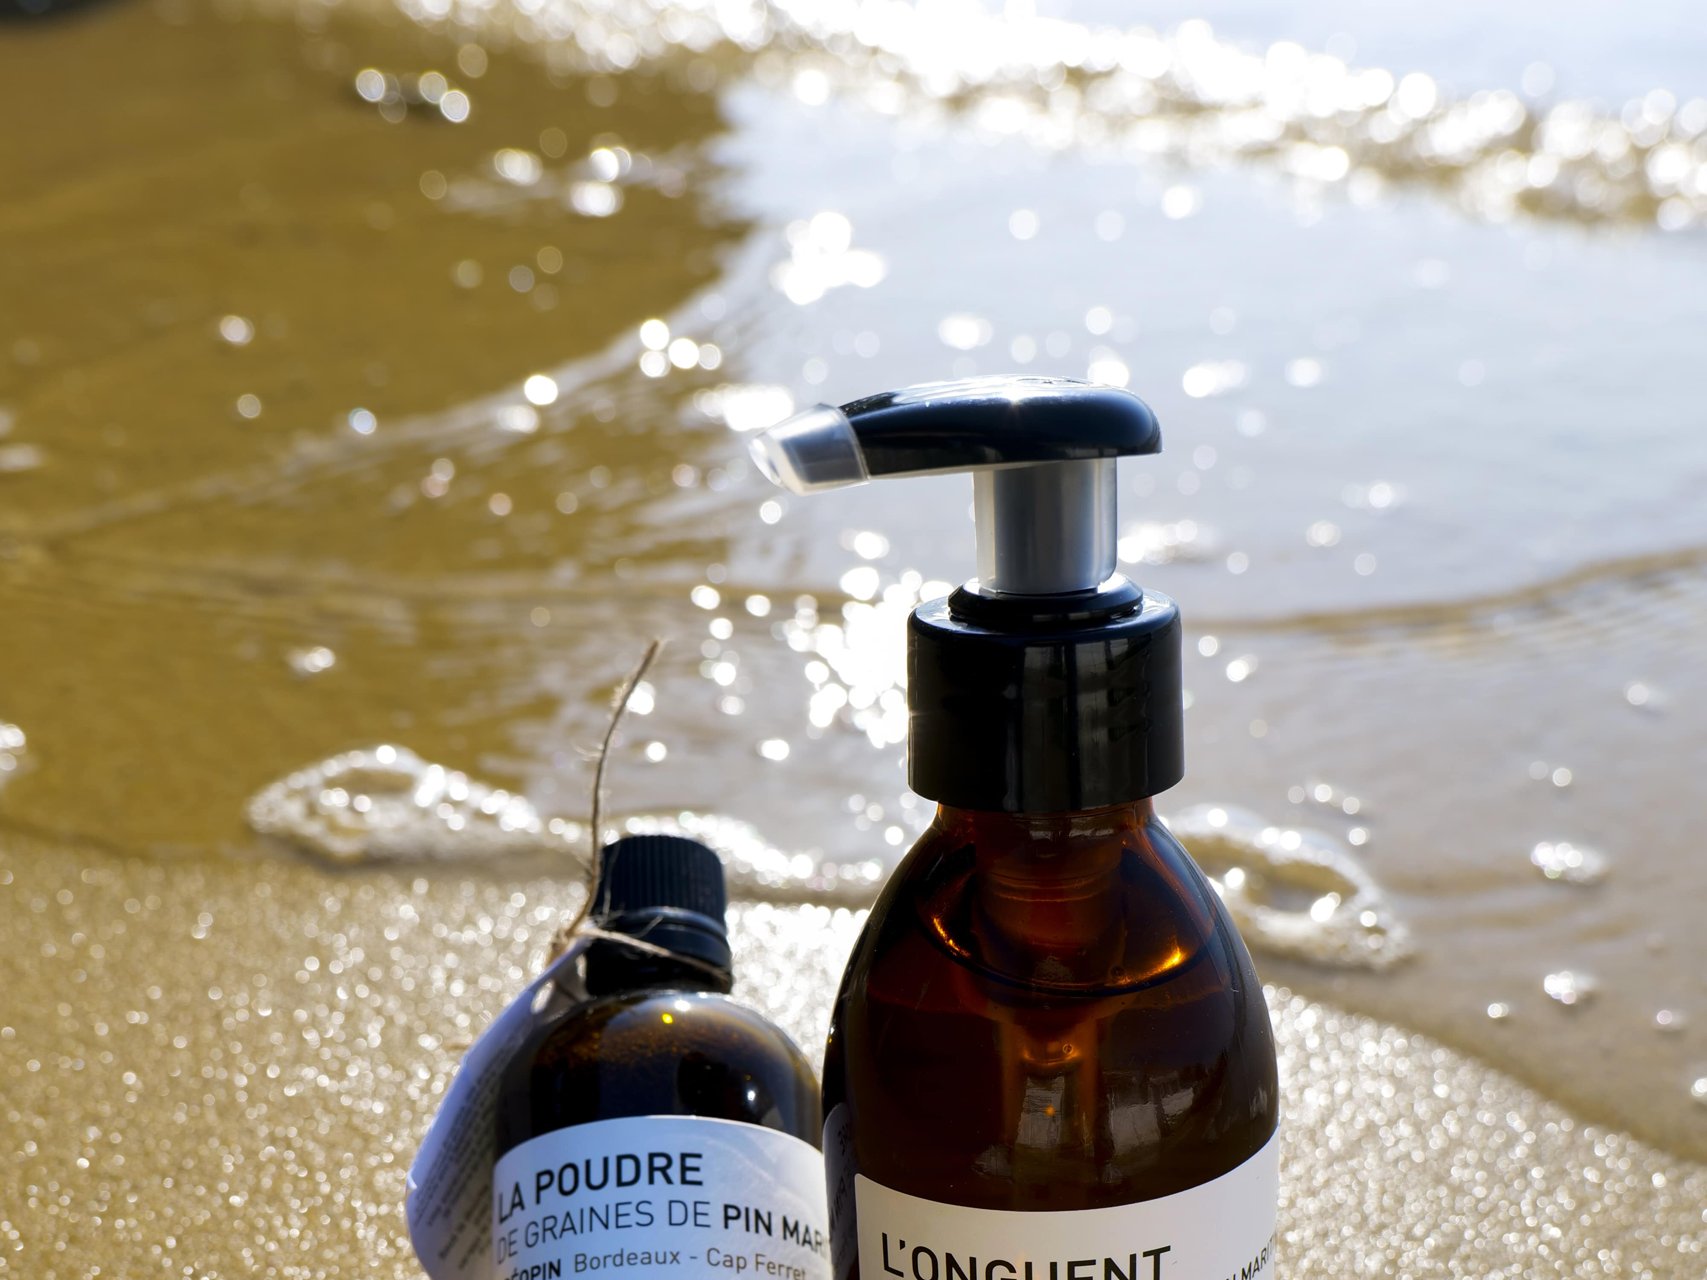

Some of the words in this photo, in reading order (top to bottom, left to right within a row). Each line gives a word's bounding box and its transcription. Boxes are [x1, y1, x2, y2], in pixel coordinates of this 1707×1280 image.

[498, 1181, 525, 1225] LA
[535, 1152, 703, 1205] POUDRE
[497, 1228, 518, 1265] DE
[525, 1200, 654, 1248] GRAINES
[668, 1200, 711, 1228] DE
[723, 1203, 773, 1237] PIN
[782, 1215, 823, 1254] MAR
[574, 1248, 681, 1273] Bordeaux
[706, 1247, 747, 1274] Cap
